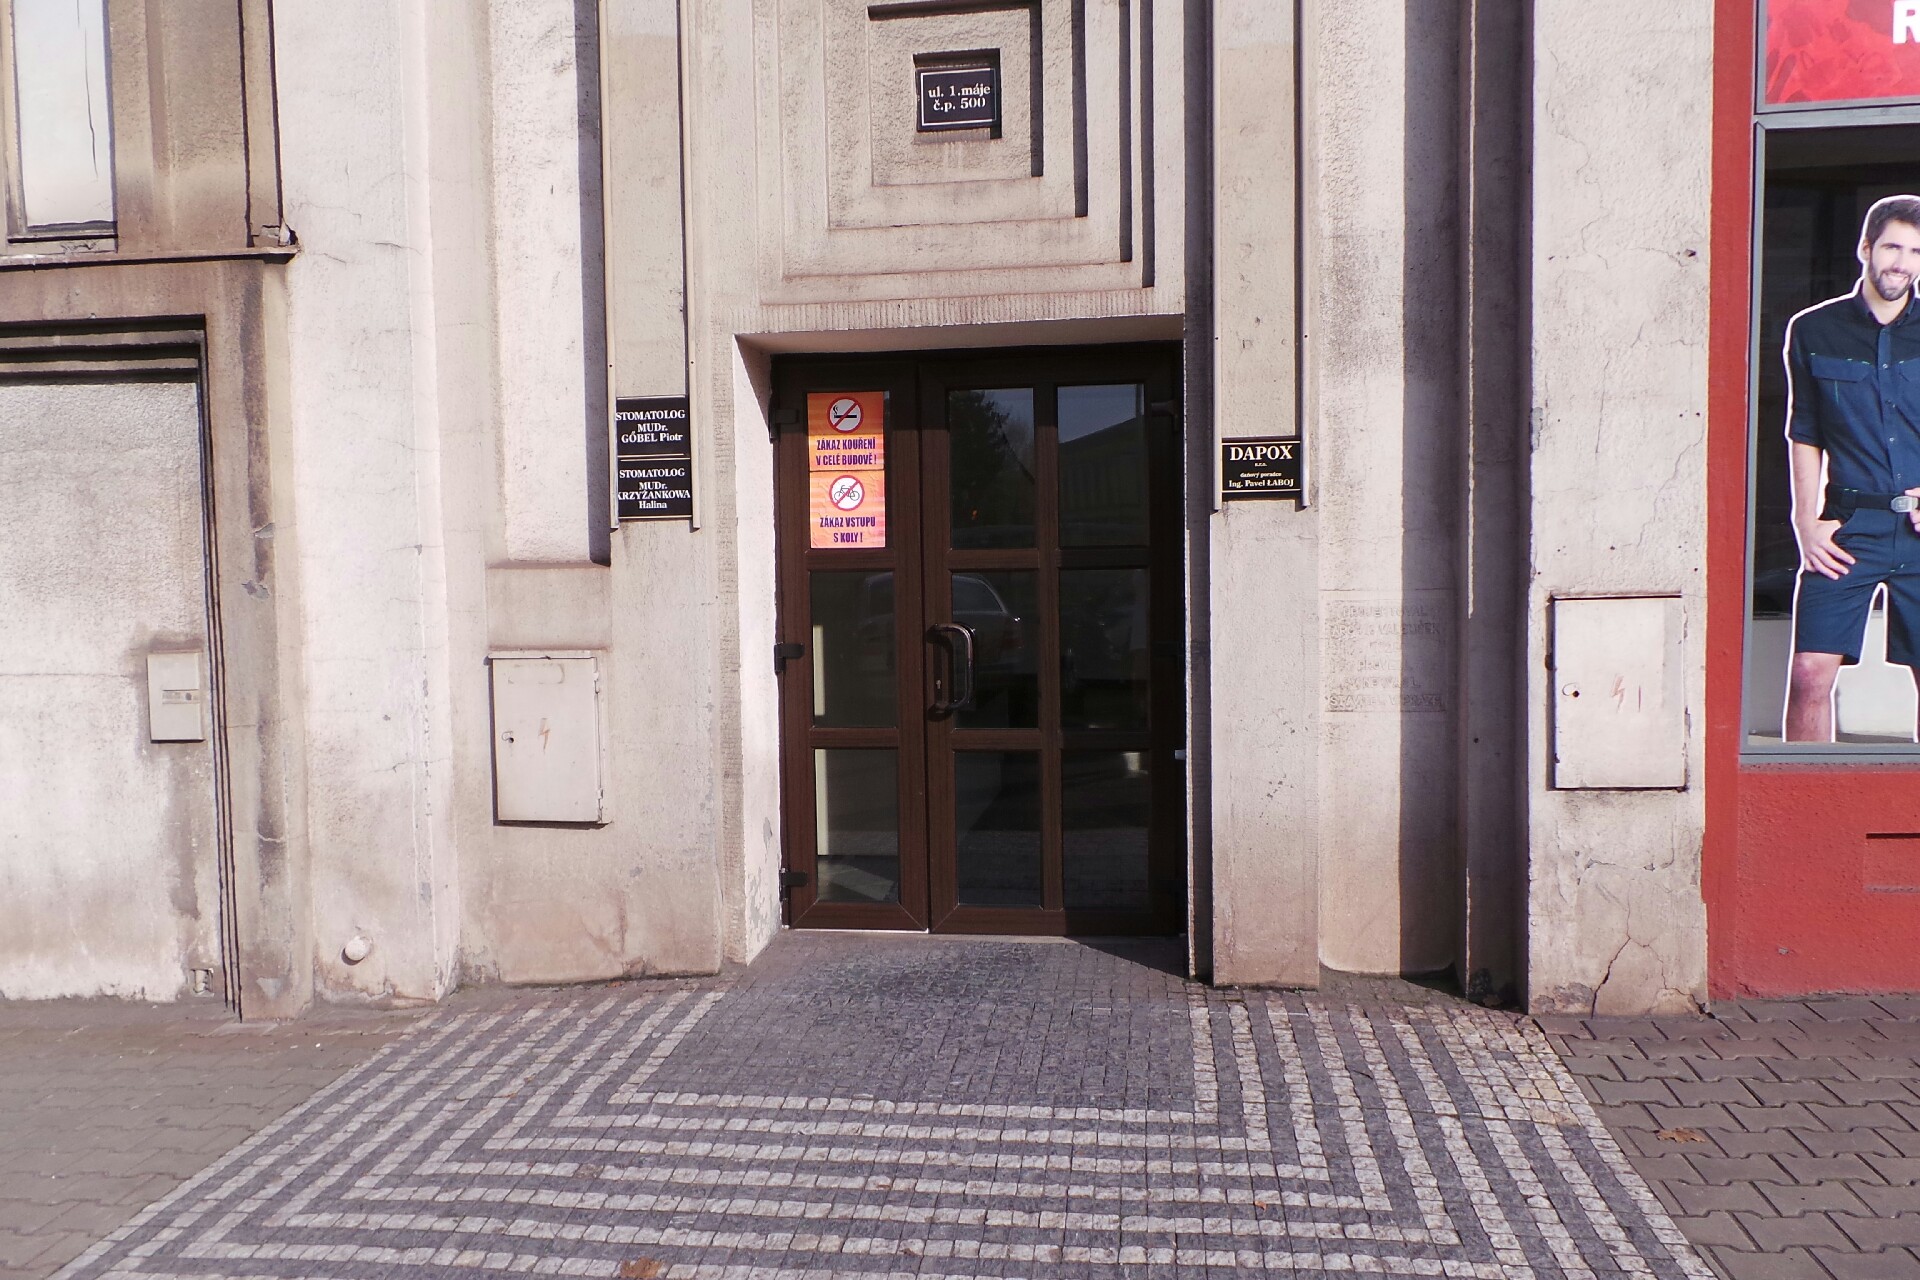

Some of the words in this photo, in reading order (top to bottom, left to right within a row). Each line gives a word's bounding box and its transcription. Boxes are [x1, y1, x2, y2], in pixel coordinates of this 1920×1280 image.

[928, 86, 944, 98] ul.
[950, 82, 990, 97] 1.máje
[933, 98, 956, 112] č.p.
[960, 97, 986, 109] 500
[615, 409, 686, 421] STOMATOLOG
[637, 423, 668, 432] MUDr.
[659, 432, 683, 442] Piotr
[816, 438, 840, 451] ZÁKAZ
[842, 438, 876, 450] KOUŘENÍ
[1229, 445, 1293, 461] DAPOX
[816, 455, 822, 466] V
[823, 452, 841, 466] CELÉ
[842, 452, 873, 465] BUDOVĚ
[619, 468, 685, 478] STOMATOLOG
[639, 481, 667, 490] MUDr.
[1229, 480, 1243, 488] Ing.
[639, 500, 667, 509] Halina
[820, 515, 843, 528] ZÁKAZ
[845, 516, 876, 527] VSTUPU
[833, 532, 839, 543] S
[840, 532, 859, 543] KOLY
